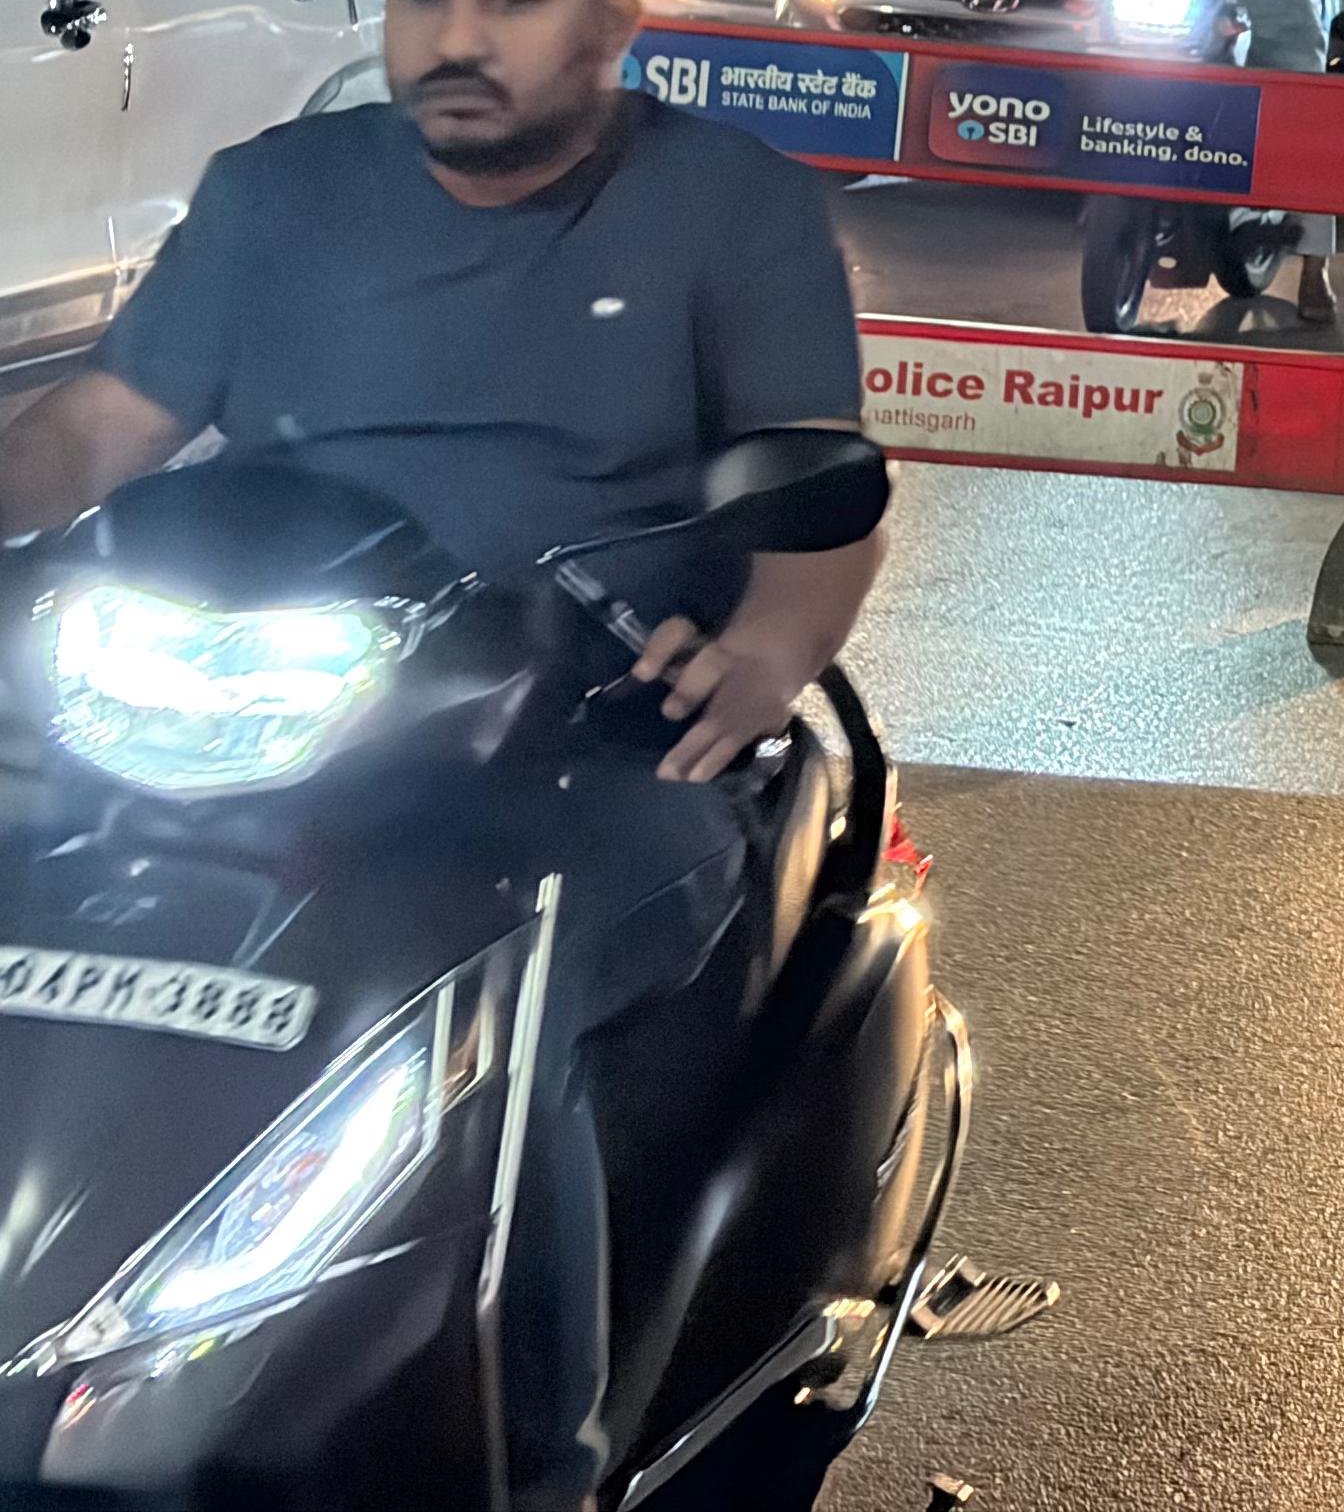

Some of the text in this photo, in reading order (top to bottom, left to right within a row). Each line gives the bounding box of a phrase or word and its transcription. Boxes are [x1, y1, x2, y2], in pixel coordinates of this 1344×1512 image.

[646, 54, 710, 108] SBI
[720, 63, 877, 99] भारतीय स्टेट बैंक
[721, 91, 872, 120] STATE BANK OF INDIA
[948, 91, 1050, 122] yono
[987, 120, 1038, 147] SBI
[1081, 115, 1203, 142] Lifestyle &
[1080, 135, 1248, 167] banking, dono.
[865, 360, 1165, 419] olice Raipur
[874, 404, 976, 433] attisgarh
